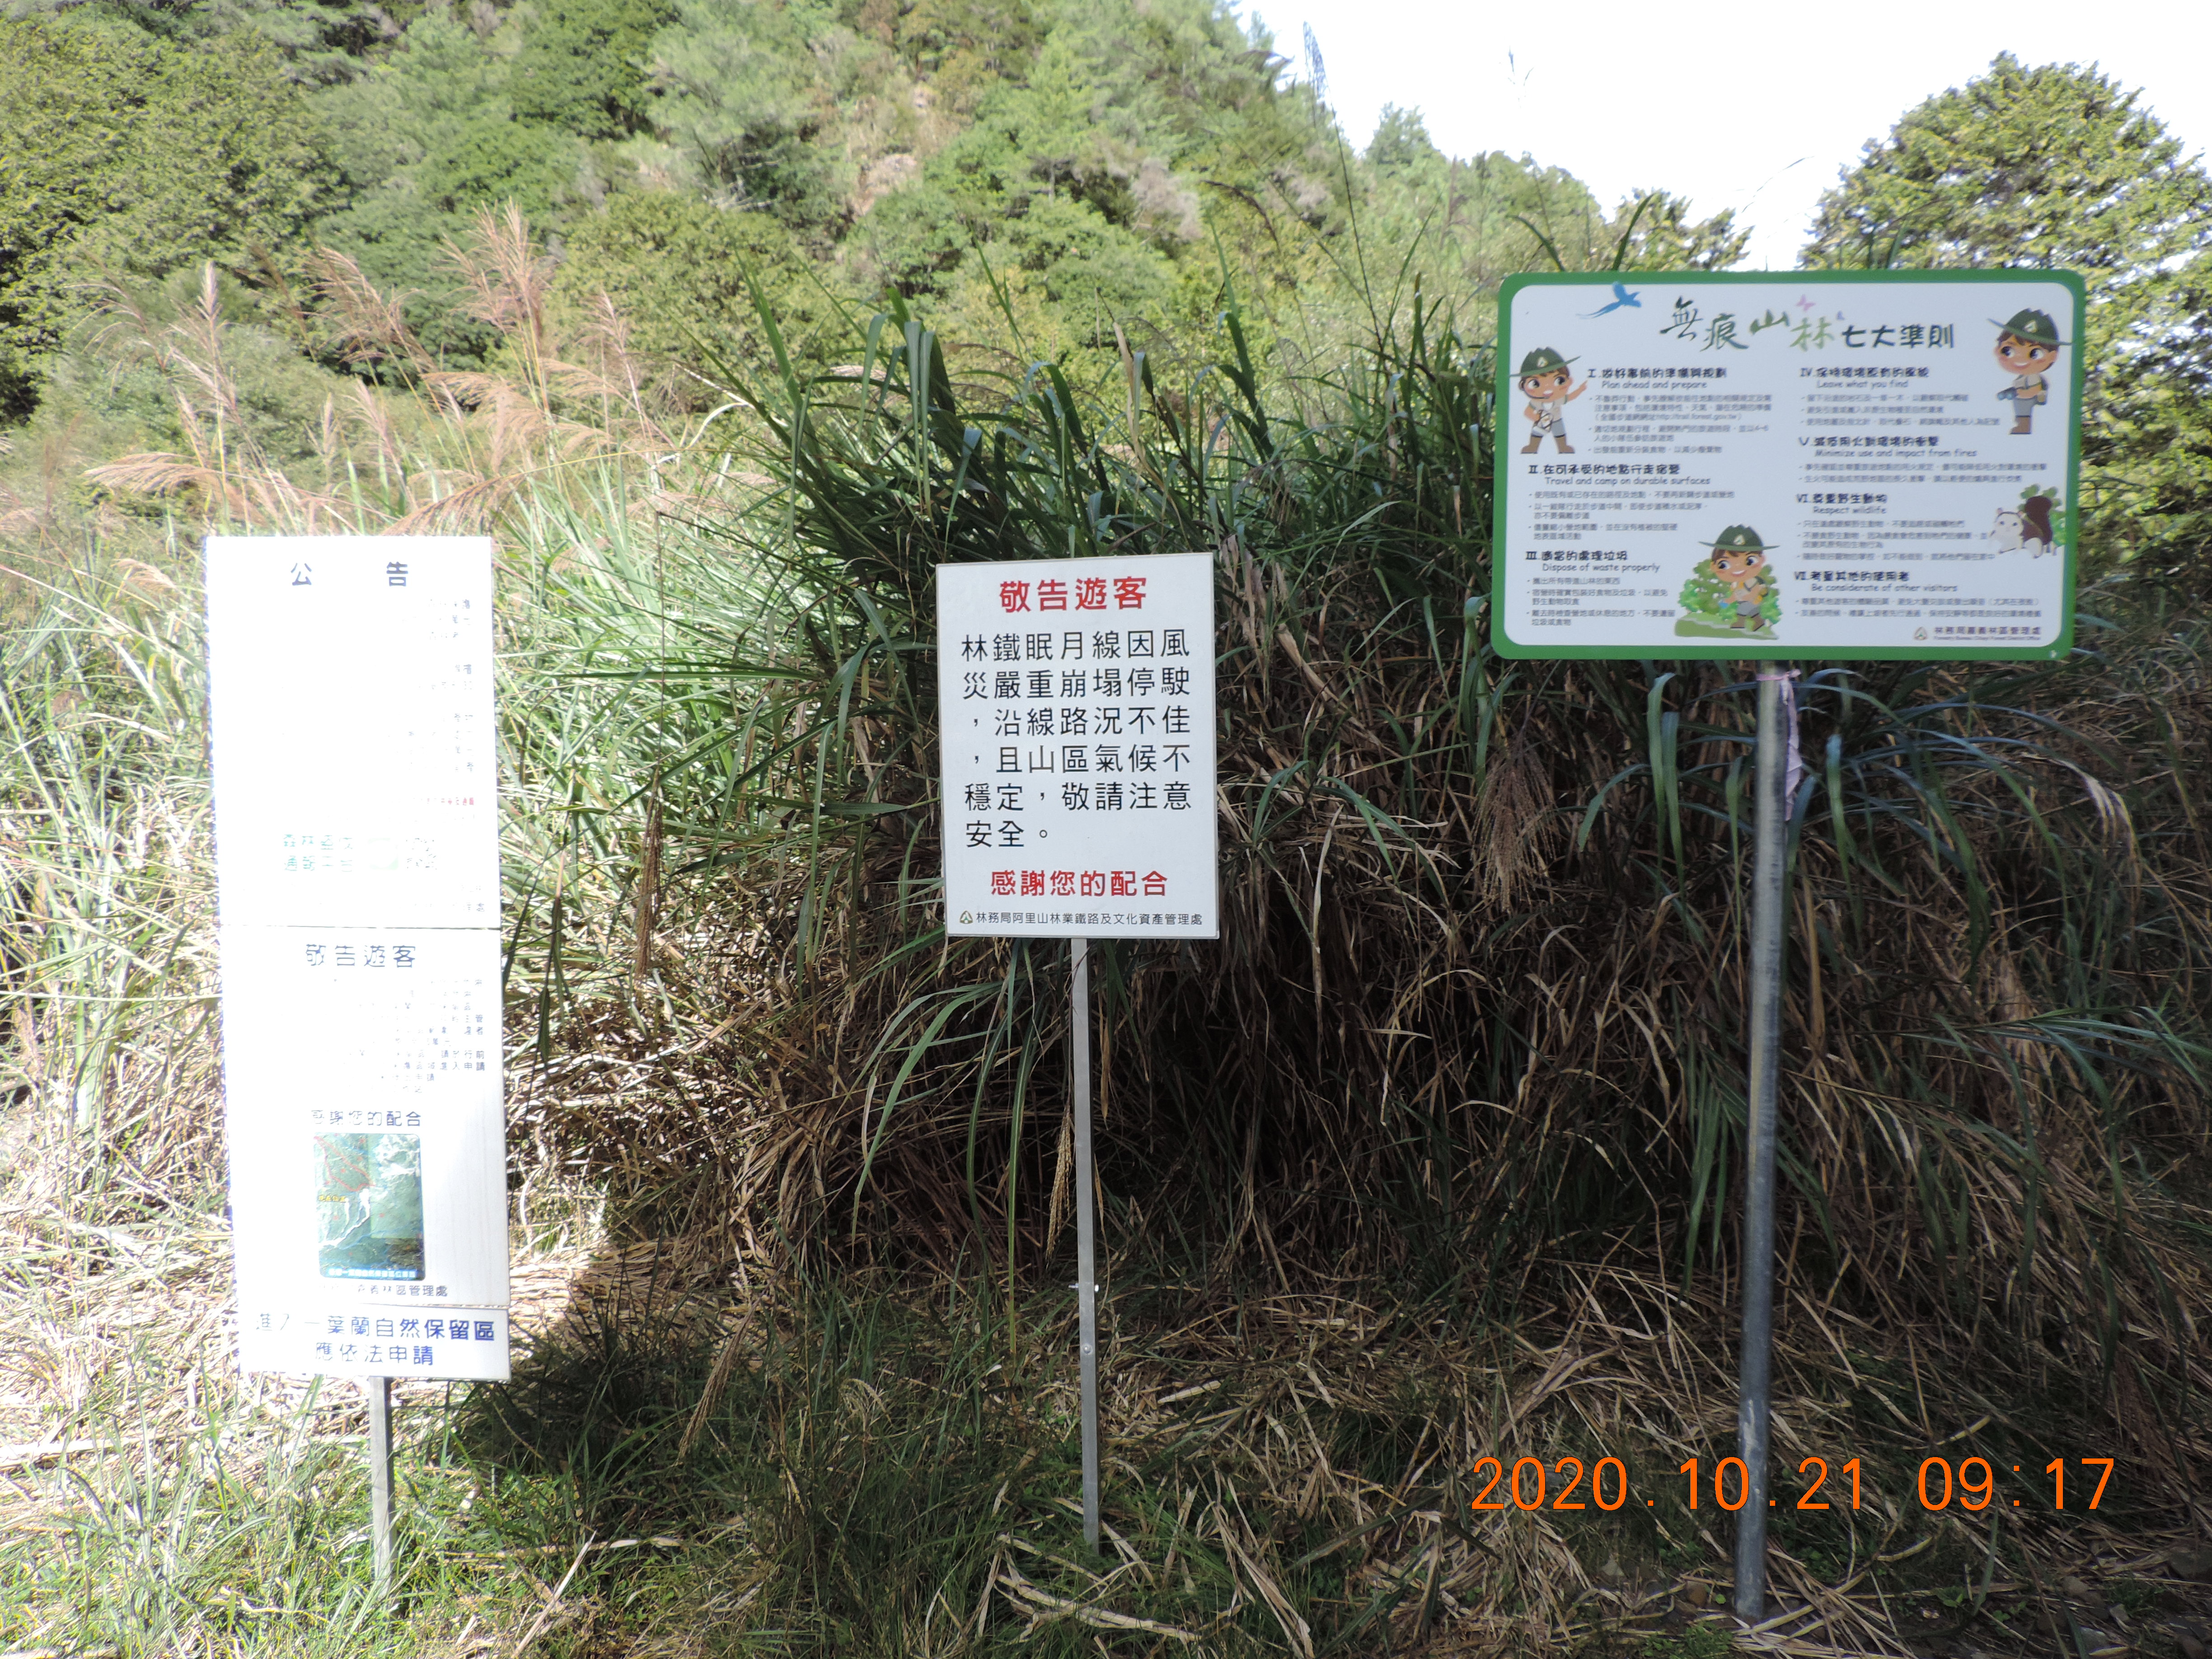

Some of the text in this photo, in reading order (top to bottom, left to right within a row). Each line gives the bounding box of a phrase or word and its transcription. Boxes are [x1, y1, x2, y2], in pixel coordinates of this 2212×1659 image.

[1659, 295, 1954, 351] 無痕山林七大準則
[1602, 380, 1620, 389] Plan
[1889, 380, 1908, 388] find
[1896, 450, 1926, 458] impact
[1671, 476, 1711, 484] surfaces
[1814, 506, 1850, 515] Respect
[290, 561, 410, 587] 公告
[1543, 563, 1577, 573] Dispose
[1580, 563, 1590, 571] of
[1622, 563, 1660, 573] properly
[1000, 576, 1146, 613] 敬告遊客
[961, 629, 1190, 661] 林鐵眠月線因風
[963, 666, 1190, 699] 災嚴重崩塌停駛
[975, 705, 1190, 736] ，沿線路況不佳
[975, 744, 1190, 773] ，且山區氣候不
[965, 781, 1191, 811] 穩定，敬請注意
[966, 820, 1047, 847] 安全。
[991, 870, 1167, 896] 感謝您的配合
[976, 912, 1202, 925] 林務局阿里山林業鐵路及文化資產管理處
[305, 945, 416, 968] 敬告遊客
[315, 1342, 434, 1366] 應依法申請
